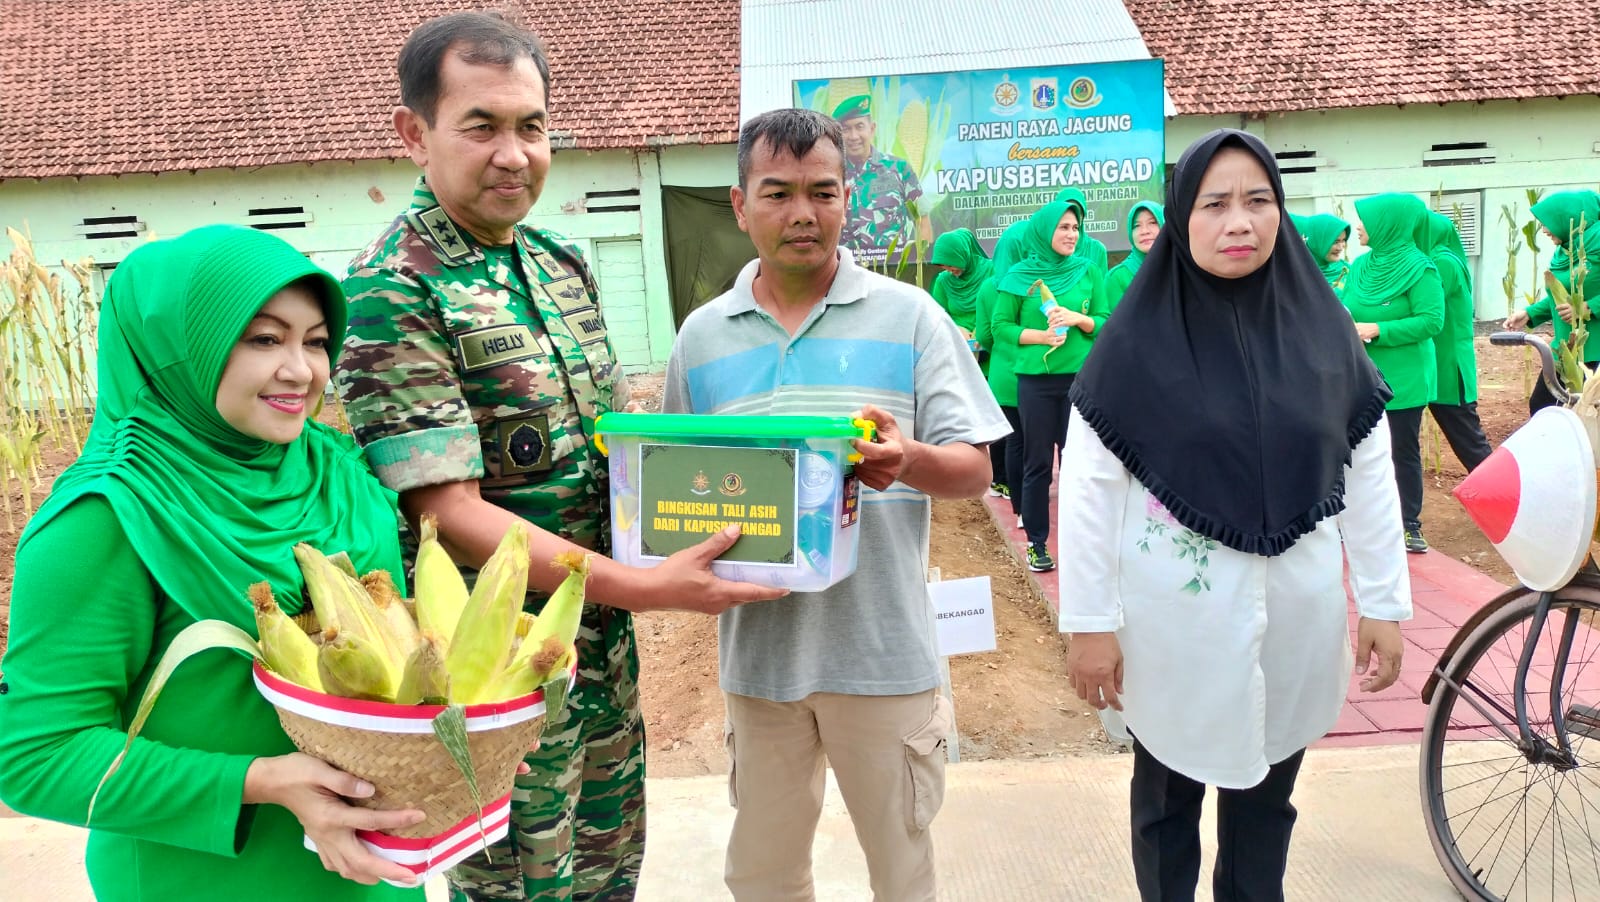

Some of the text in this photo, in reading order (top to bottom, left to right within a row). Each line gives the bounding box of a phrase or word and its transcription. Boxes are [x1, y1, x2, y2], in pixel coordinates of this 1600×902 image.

[959, 114, 1132, 141] PANEN RAYA JAGUNG
[1008, 142, 1079, 160] bersama
[938, 158, 1153, 193] KAPUSBEKANGAD
[955, 195, 989, 209] DALAM
[992, 192, 1034, 207] RANGKA
[1096, 187, 1138, 200] PANGAN
[999, 215, 1007, 225] DI
[482, 333, 525, 356] HELLY
[657, 500, 777, 519] BINGKISAN TALI ASIH
[654, 517, 679, 531] DARI
[936, 608, 985, 620] BEKANGAD
